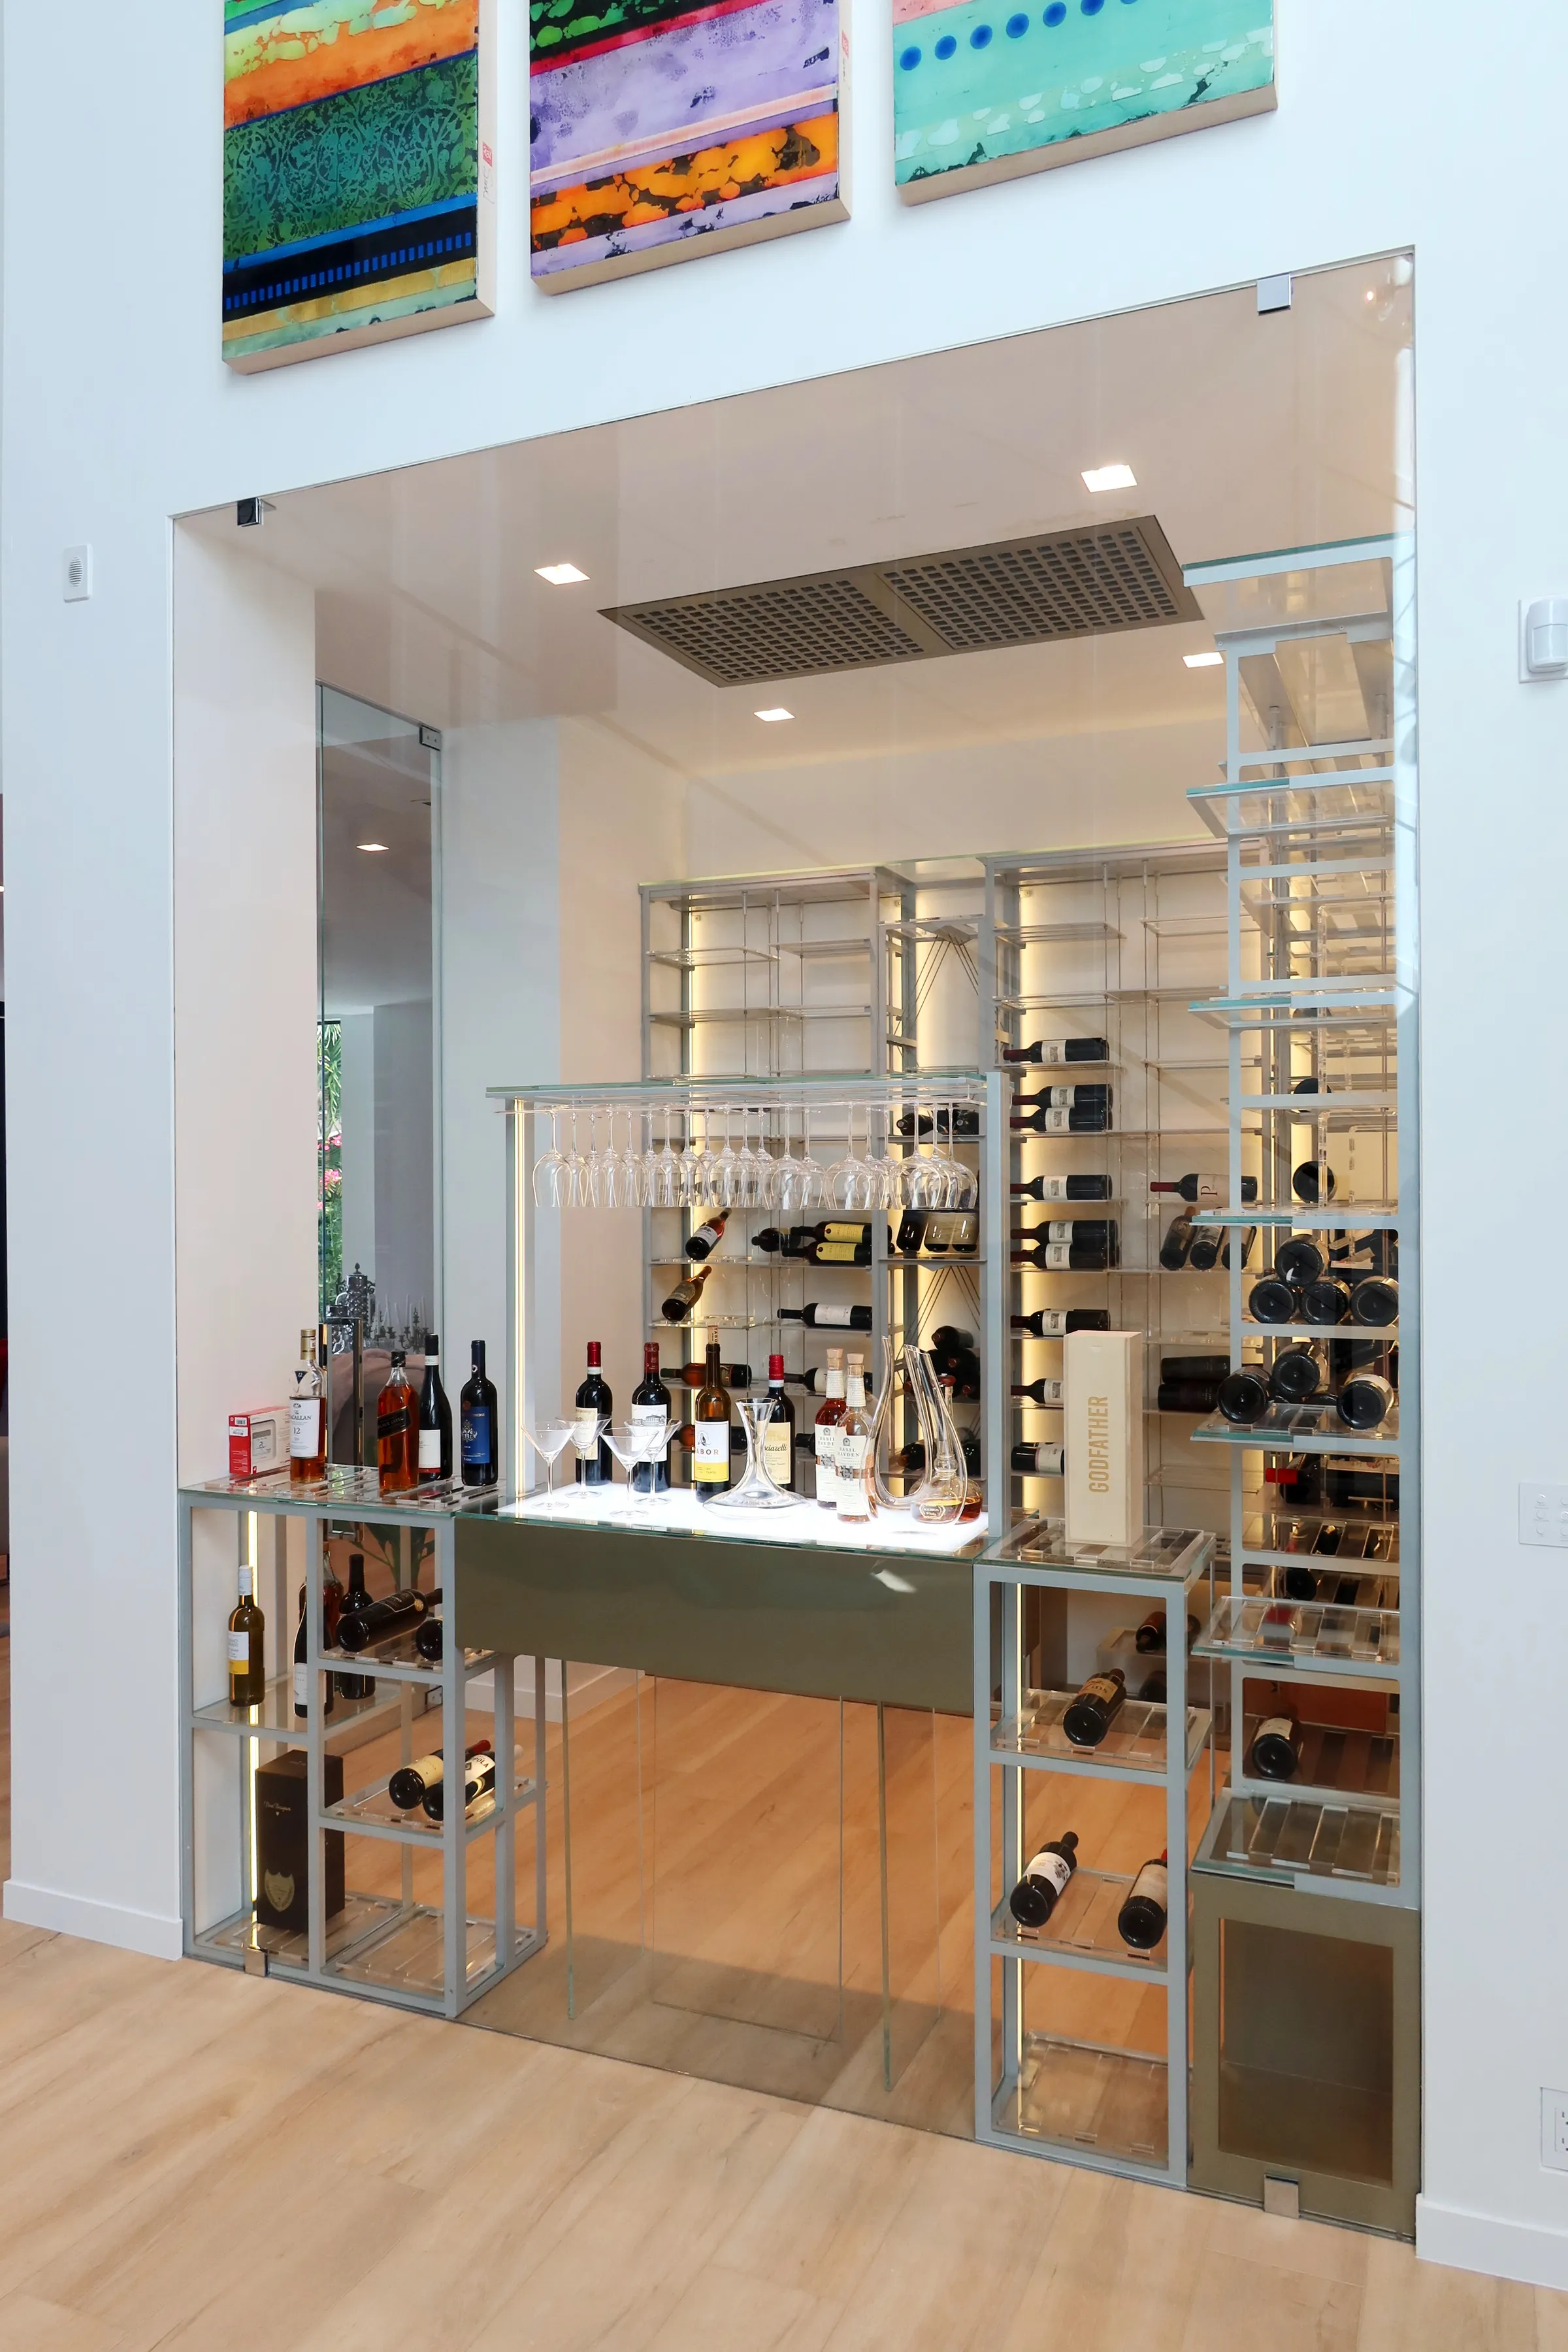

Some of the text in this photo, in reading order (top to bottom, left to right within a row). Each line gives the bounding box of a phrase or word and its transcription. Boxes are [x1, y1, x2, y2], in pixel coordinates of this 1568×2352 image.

[764, 1443, 787, 1452] sciarelli
[1088, 1396, 1109, 1493] GODFATHER
[472, 1757, 489, 1768] POLA
